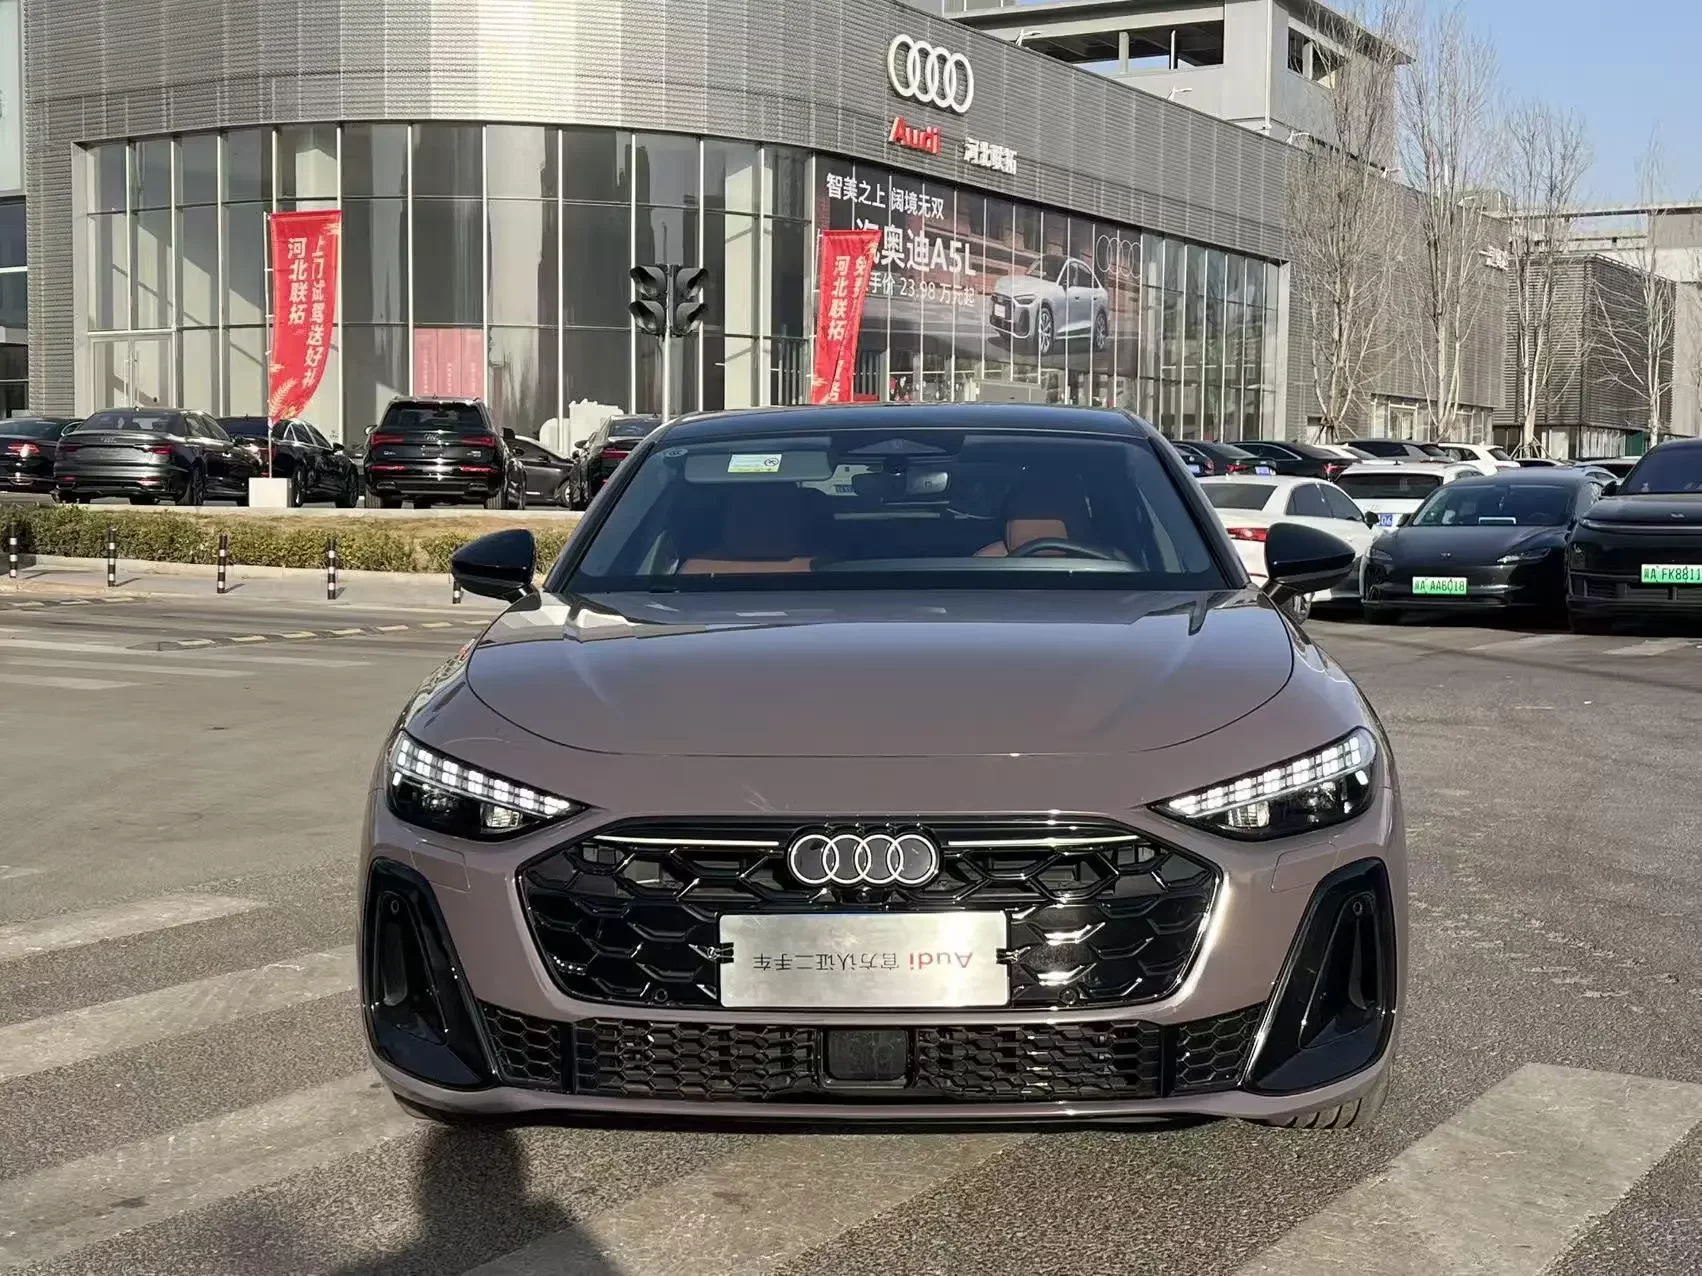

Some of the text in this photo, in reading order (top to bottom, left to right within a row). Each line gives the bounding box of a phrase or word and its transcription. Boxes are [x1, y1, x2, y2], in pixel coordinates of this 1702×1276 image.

[888, 116, 941, 154] Audi
[826, 173, 944, 220] 智美之上 阔境无双
[288, 237, 308, 326] 河北联拓
[828, 255, 850, 341] 河北联拓
[900, 277, 936, 300] 23.98
[940, 283, 975, 307] 万元起
[303, 236, 325, 388] 上门试驾送好礼
[753, 952, 973, 971] Audi 官方认证二手车
